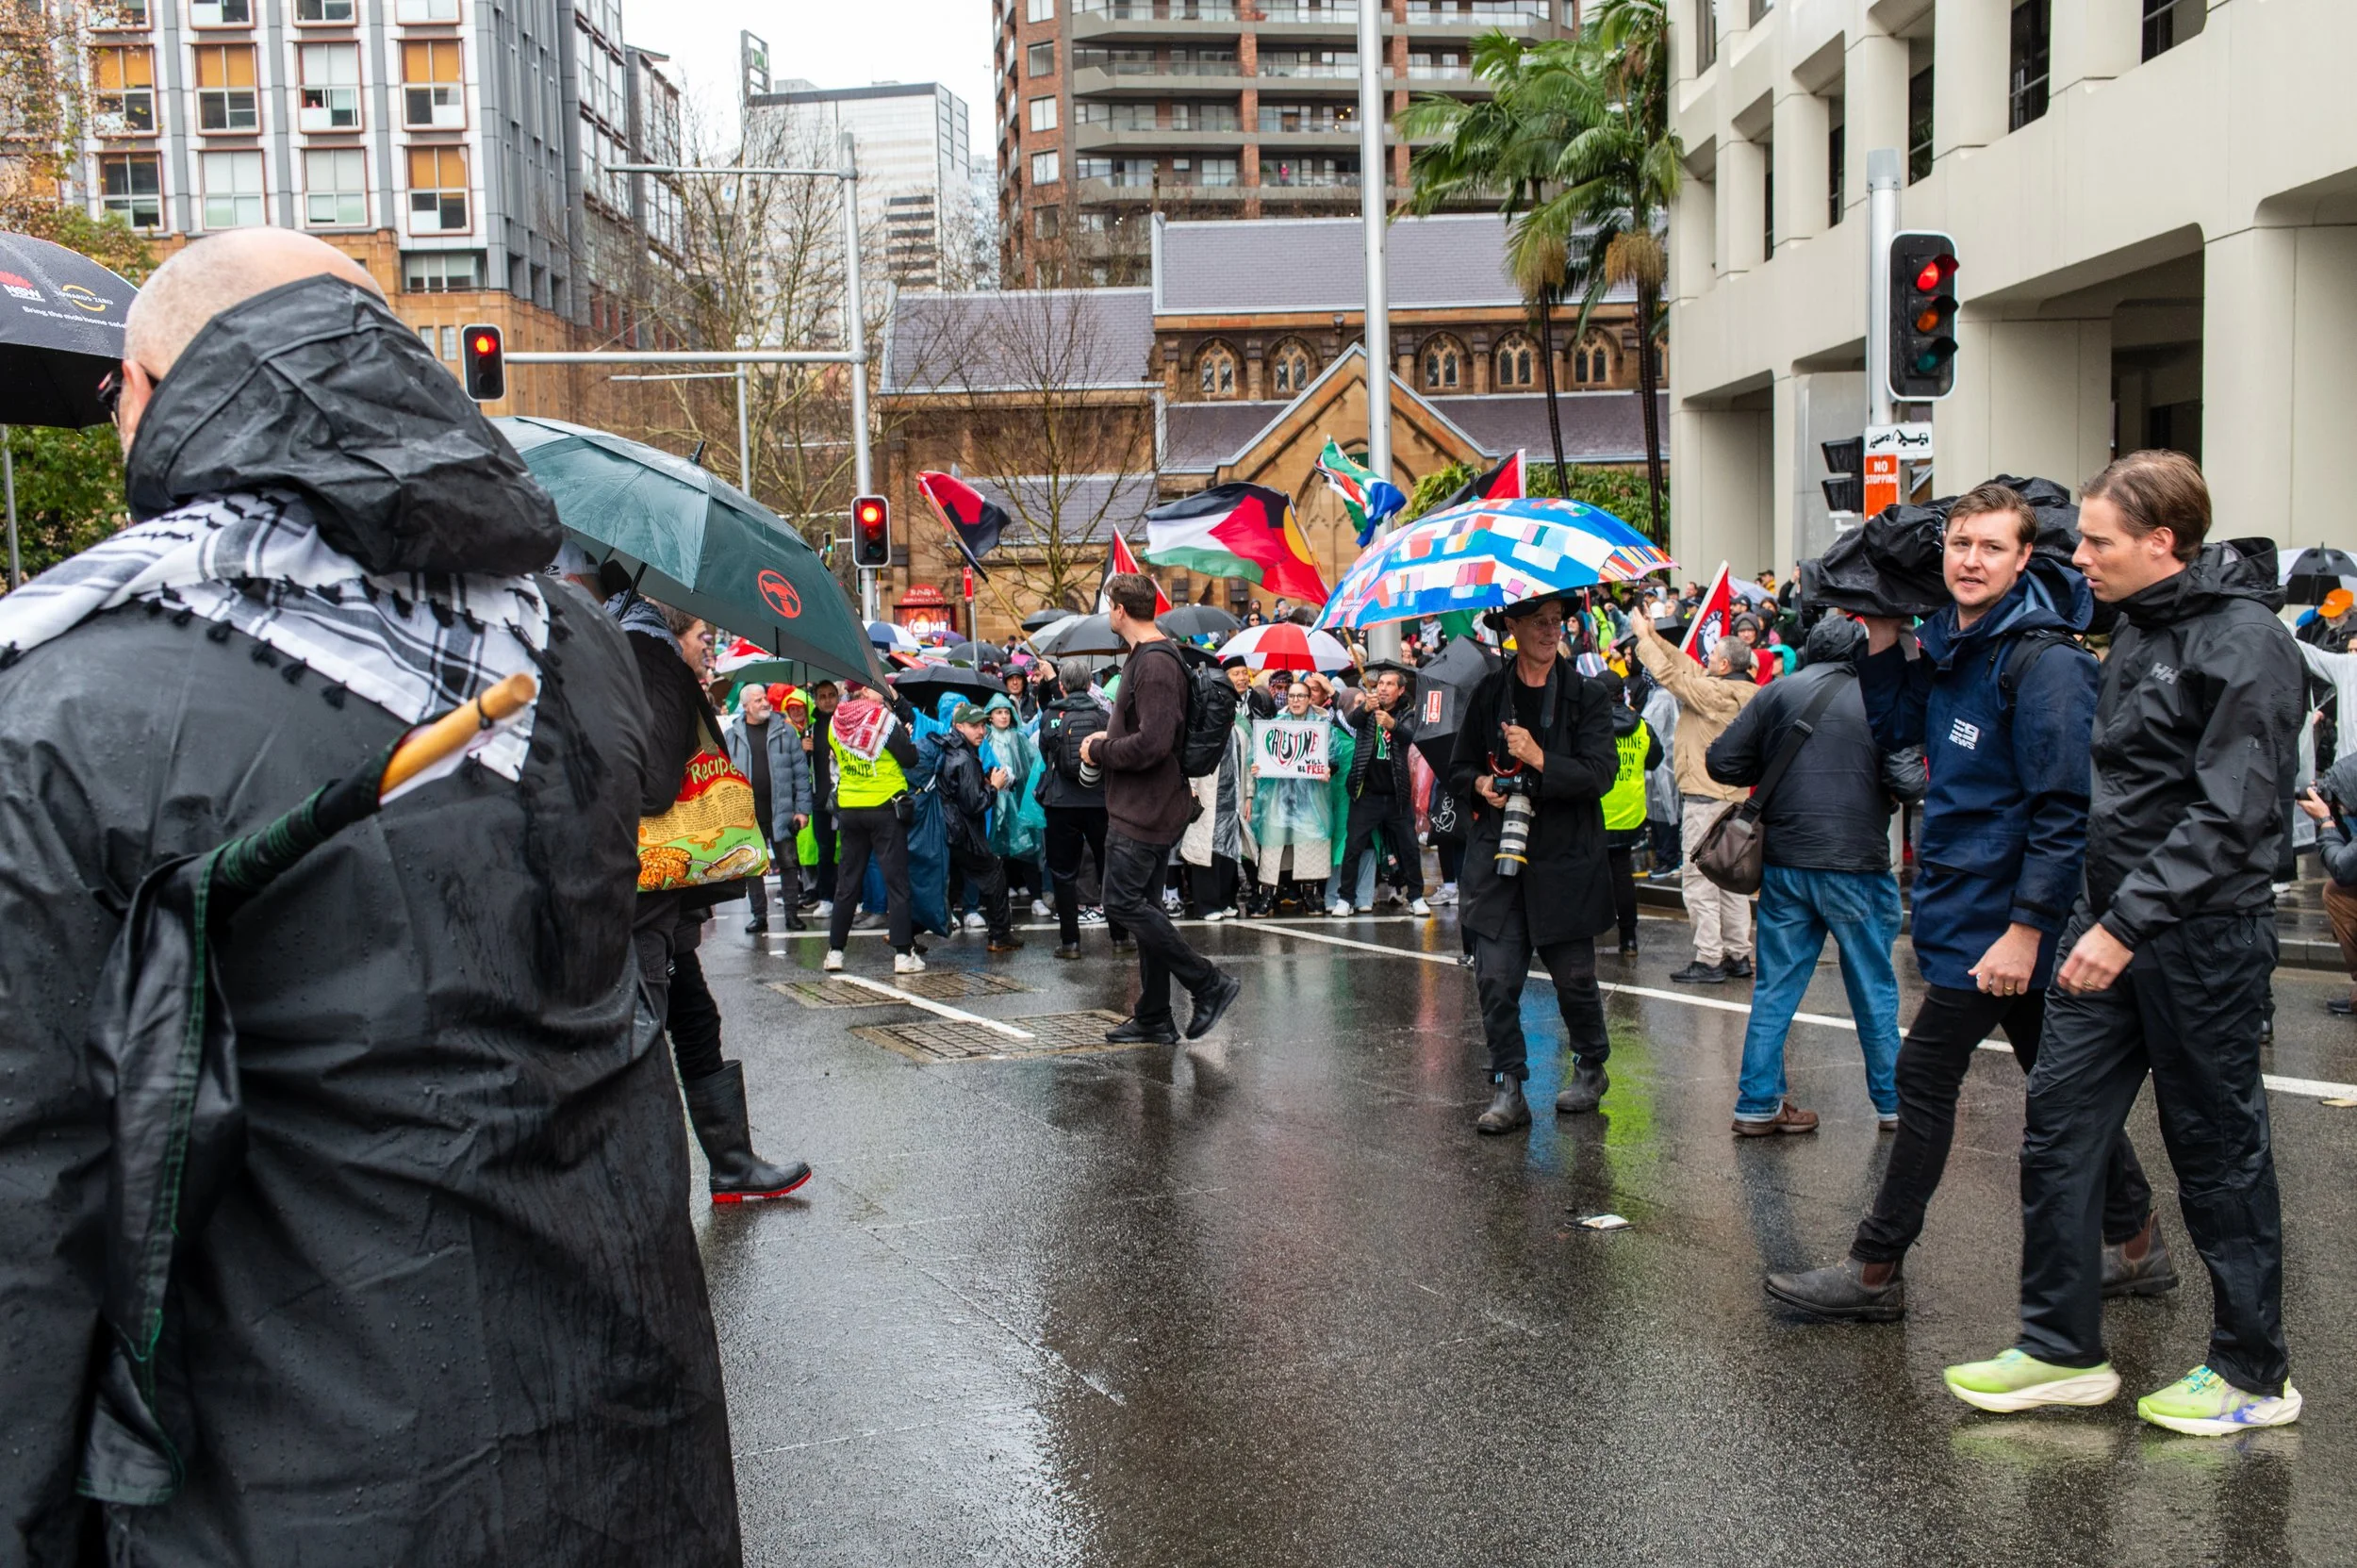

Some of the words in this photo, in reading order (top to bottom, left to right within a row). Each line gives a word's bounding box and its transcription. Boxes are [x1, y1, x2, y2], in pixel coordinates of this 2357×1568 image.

[92, 297, 114, 305] ZERO
[23, 305, 48, 317] Bring
[48, 310, 63, 319] the
[83, 316, 107, 326] home
[1873, 460, 1888, 472] NO
[1865, 473, 1898, 486] STOPPING
[1265, 728, 1320, 767] PALESTINE
[1948, 733, 1976, 751] NEWS
[1307, 765, 1326, 775] FREE
